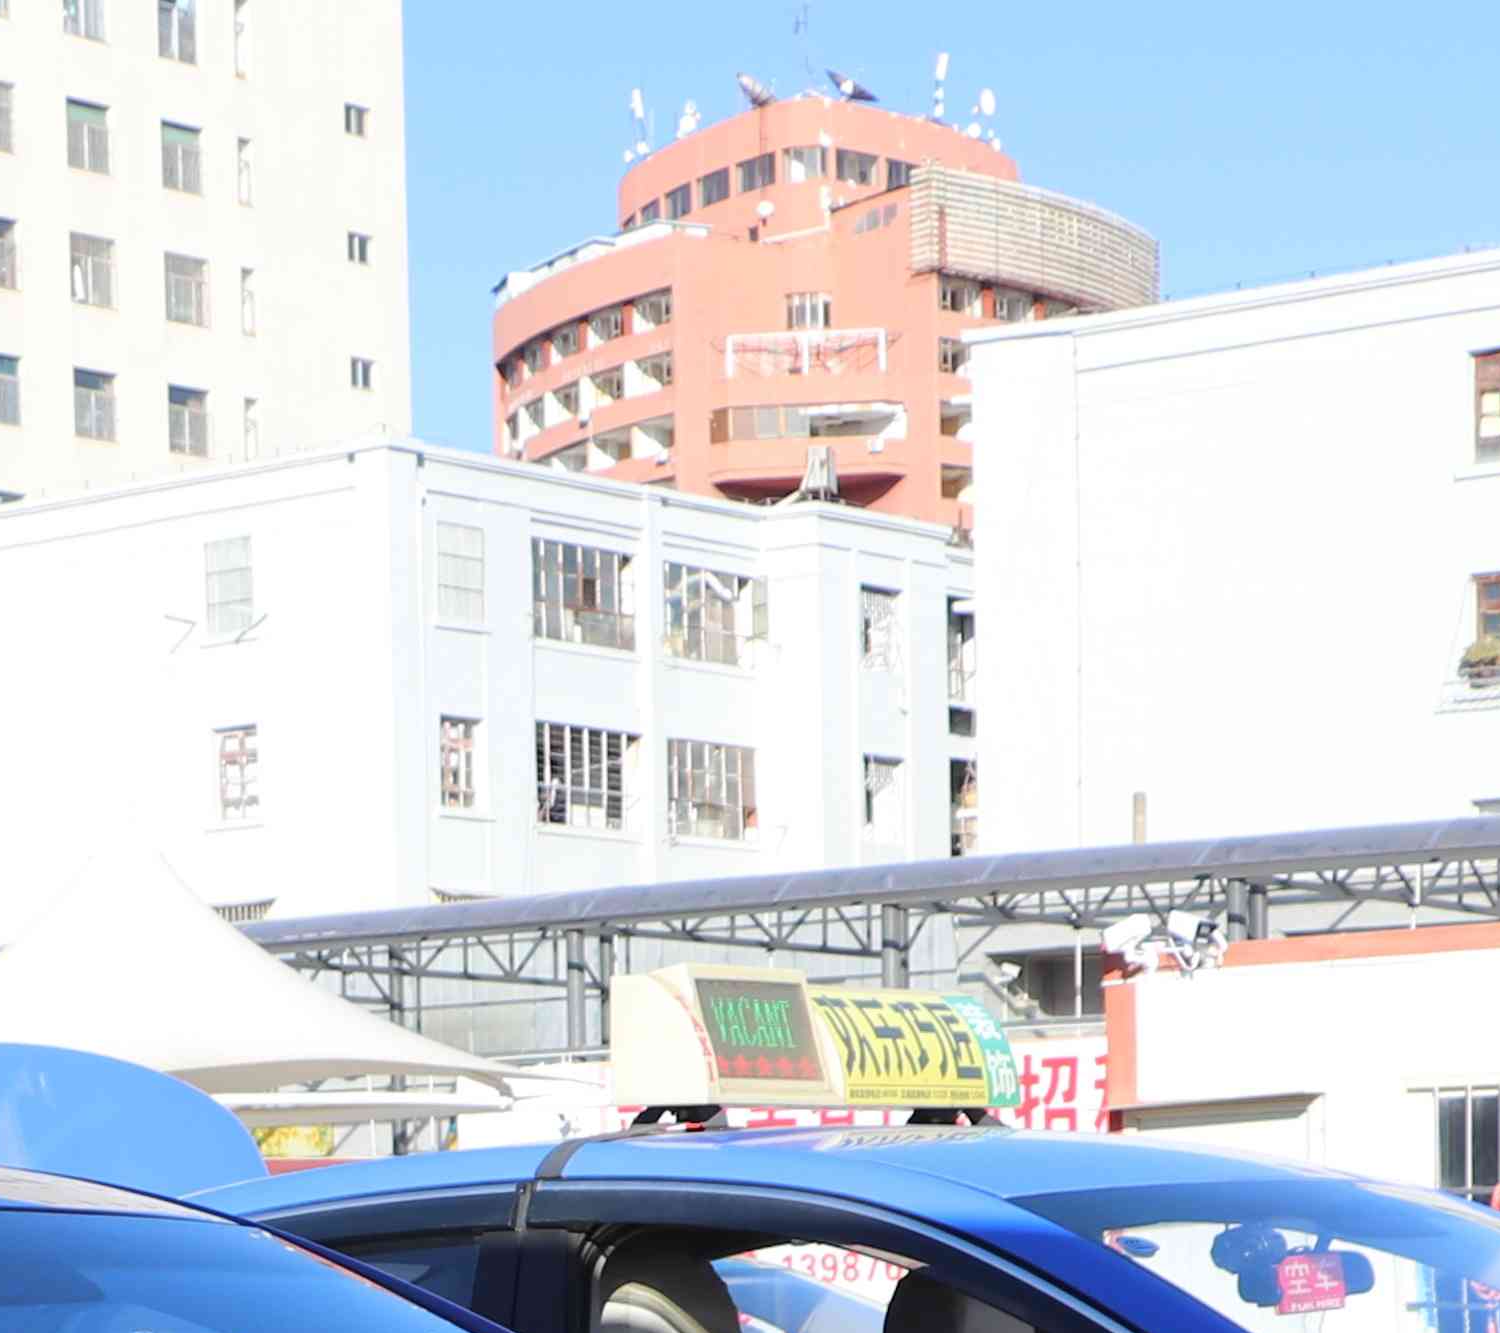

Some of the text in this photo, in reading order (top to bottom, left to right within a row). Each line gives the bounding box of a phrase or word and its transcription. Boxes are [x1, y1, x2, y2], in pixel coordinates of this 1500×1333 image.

[709, 997, 799, 1049] VACANT
[811, 994, 984, 1080] 欢乐巧匠
[954, 1001, 1018, 1100] 装饰
